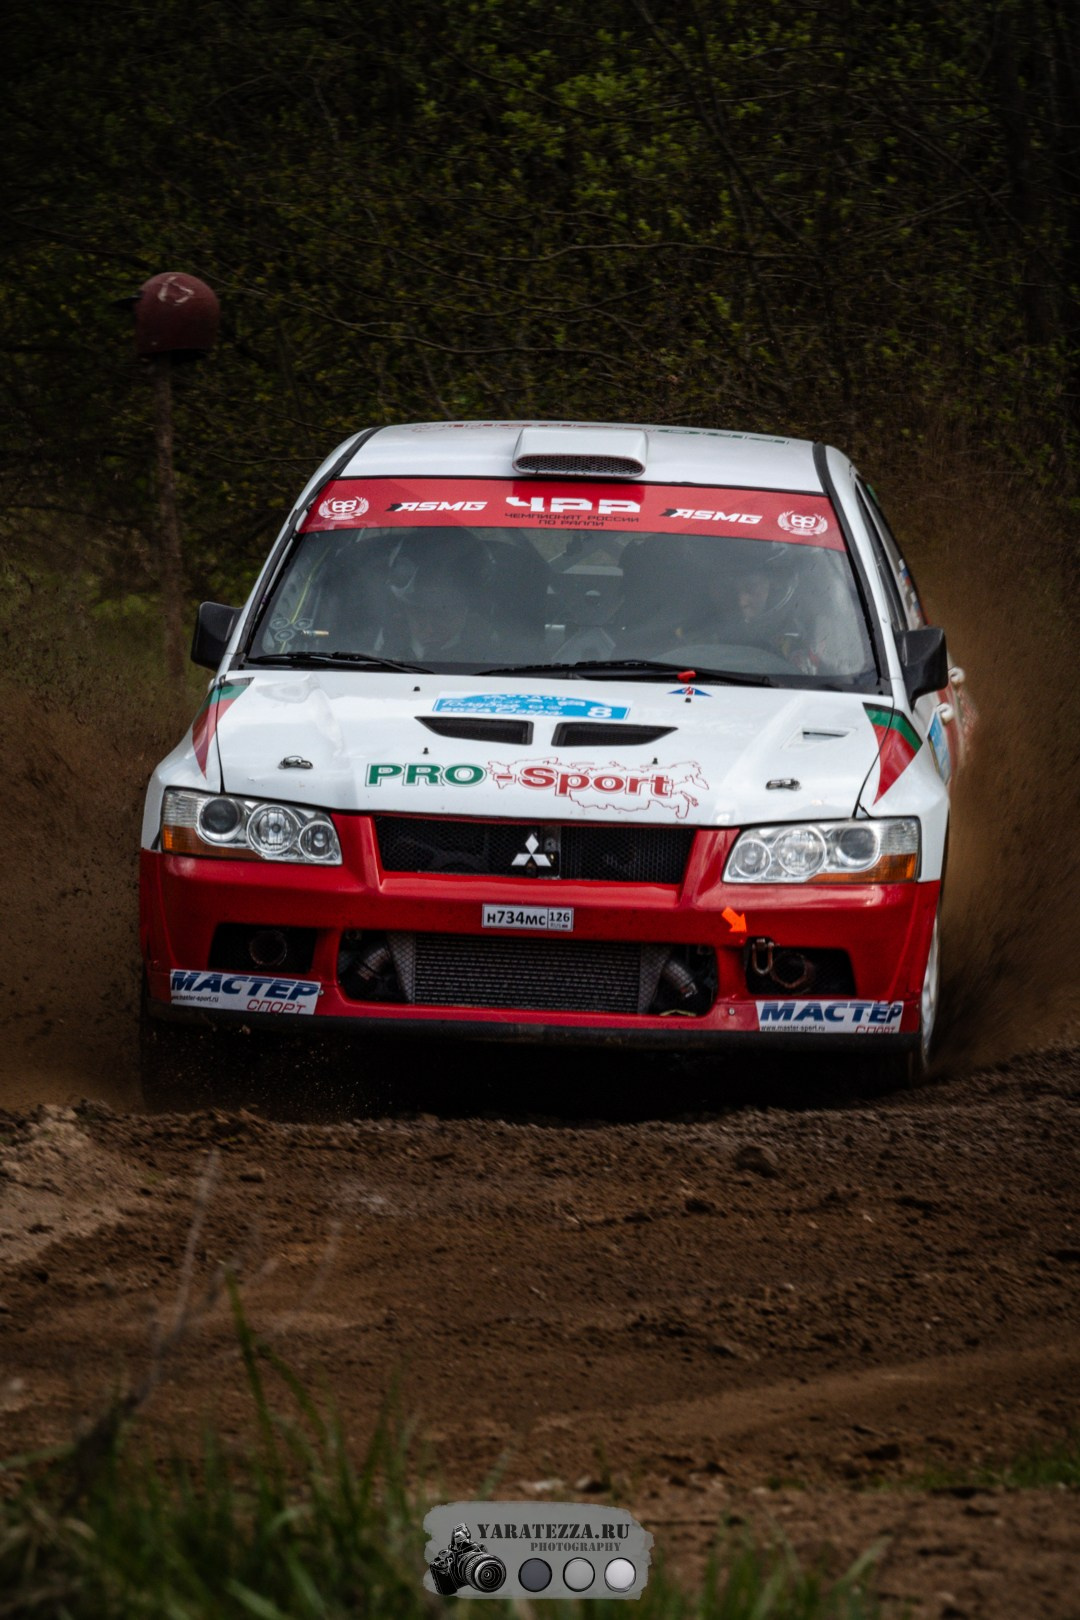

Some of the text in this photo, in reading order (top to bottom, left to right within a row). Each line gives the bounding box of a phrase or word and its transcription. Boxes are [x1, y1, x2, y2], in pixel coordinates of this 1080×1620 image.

[394, 501, 488, 512] ASMG
[504, 512, 640, 523] ЧЕМПИОНАТ РОССИИ
[669, 508, 763, 524] ASMG
[587, 706, 613, 719] 8
[549, 911, 571, 923] 126
[170, 971, 320, 1001] МАСТЕР
[246, 998, 307, 1014] СПОРТ
[759, 1002, 903, 1024] МАСТЕР
